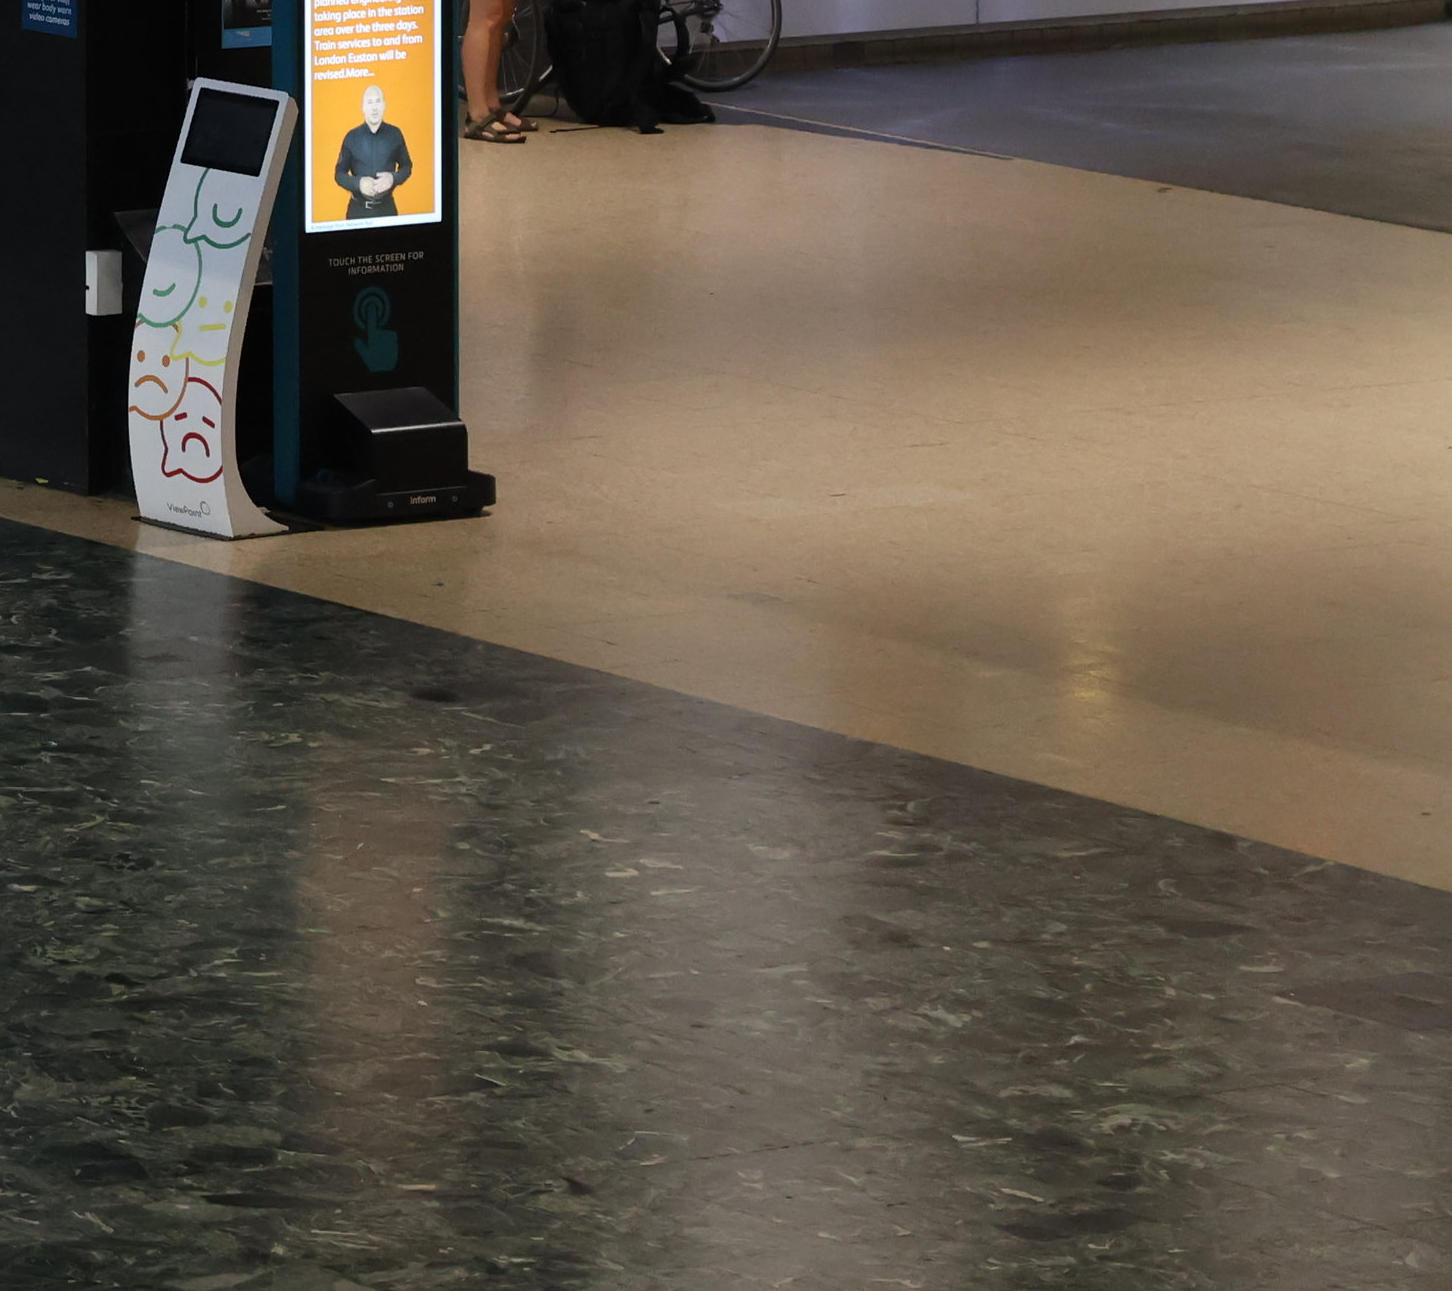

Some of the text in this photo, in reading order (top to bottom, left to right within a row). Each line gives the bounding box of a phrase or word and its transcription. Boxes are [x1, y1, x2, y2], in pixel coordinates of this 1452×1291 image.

[314, 5, 424, 22] taking place in the station
[329, 251, 424, 267] TOUCH THE SCREEN FOR
[348, 264, 404, 275] INFORMATION
